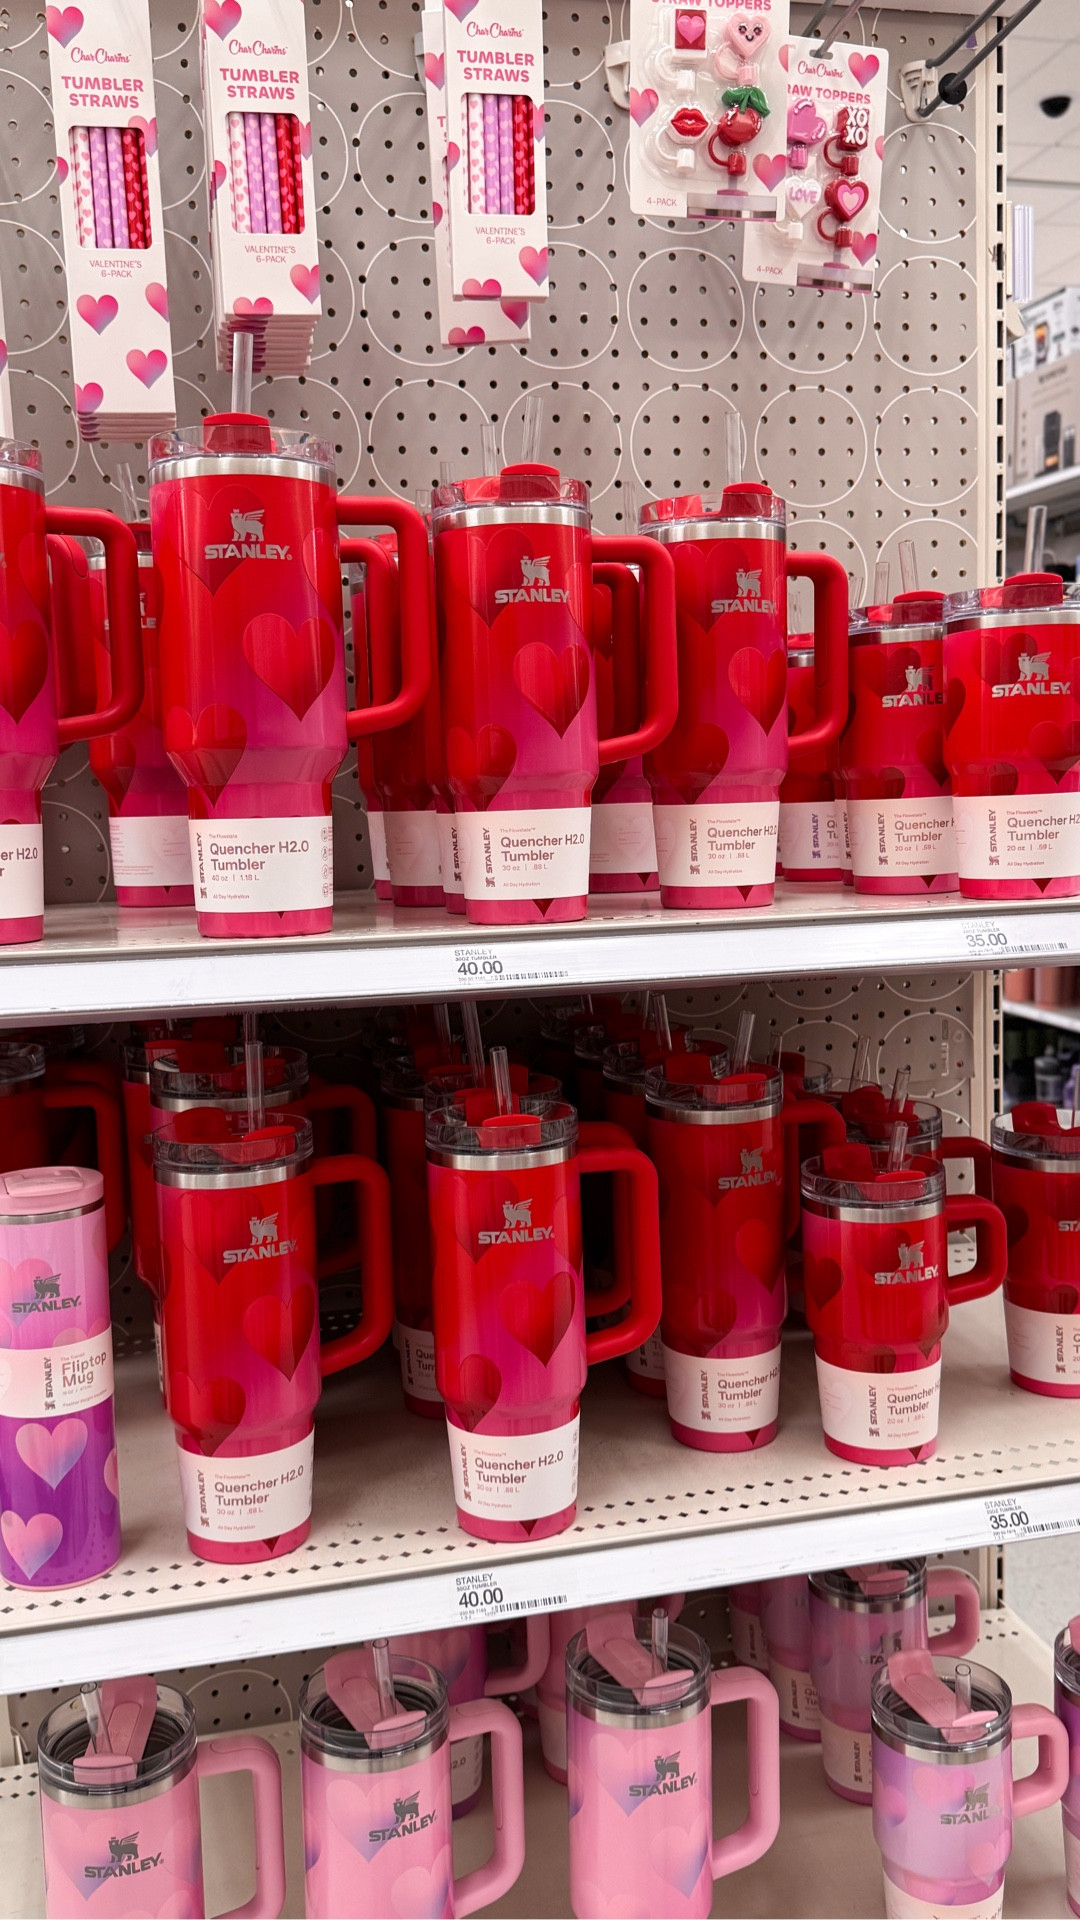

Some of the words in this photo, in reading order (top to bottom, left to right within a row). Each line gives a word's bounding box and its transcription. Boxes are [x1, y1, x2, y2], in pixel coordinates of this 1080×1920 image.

[457, 50, 535, 66] TUMBLER
[219, 68, 300, 84] TUMBLER
[463, 67, 530, 83] STRAWS
[61, 76, 144, 92] TUMBLER
[69, 93, 139, 108] STRAWS
[227, 85, 295, 100] STRAWS
[816, 87, 871, 104] TOPPERS
[846, 107, 868, 127] XO
[845, 126, 867, 145] XO
[646, 197, 677, 207] 4-PACK
[788, 187, 817, 204] LOVE
[476, 227, 526, 236] VALENTINE'S
[486, 236, 516, 245] 6-PACK
[245, 245, 296, 254] VALENTINE'S
[89, 260, 143, 269] VALENTINE'S
[255, 255, 287, 263] 6-PACK
[101, 269, 132, 278] 6-PACK
[204, 543, 291, 560] STANLEY
[494, 588, 570, 604] STANLEY
[711, 598, 777, 613] STANLEY
[991, 681, 1069, 698] STANLEY
[882, 692, 943, 708] STANLE
[894, 818, 950, 831] Quencher
[1007, 816, 1068, 828] Quencher
[1069, 814, 1080, 824] H2
[707, 826, 763, 838] Quencher
[878, 813, 886, 853] STANLEY
[894, 832, 943, 842] Tumbler
[988, 809, 997, 853] STANLEY
[1007, 830, 1060, 841] Tumbler
[210, 842, 276, 856] Quencher
[278, 840, 309, 853] H2.0
[500, 836, 563, 848] Quencher
[565, 834, 585, 845] H2.0
[689, 818, 698, 862] STANLEY
[707, 840, 756, 851] Tumbler
[16, 847, 39, 860] H2.0
[196, 832, 206, 883] STANLEY
[483, 827, 493, 874] STANLEY
[501, 850, 555, 862] Tumbler
[210, 858, 266, 871] Tumbler
[966, 932, 1008, 947] 35.00
[454, 949, 493, 957] STANLEY
[457, 960, 503, 975] 40.00
[478, 1226, 553, 1244] STANLEY
[223, 1238, 297, 1264] STANLEY
[874, 1264, 937, 1285] STANLEY
[12, 1296, 81, 1313] STANLEY
[61, 1351, 107, 1376] Fliptop
[44, 1357, 54, 1398] STANLEY
[62, 1370, 94, 1388] Mug
[718, 1374, 768, 1389] Quencher
[700, 1370, 709, 1408] STANLEY
[718, 1388, 762, 1401] Tumbler
[887, 1386, 934, 1404] Quencher
[868, 1385, 878, 1425] STANLEY
[887, 1401, 930, 1415] Tumbler
[475, 1457, 536, 1471] Quencher
[538, 1450, 564, 1467] H2.0
[214, 1479, 279, 1493] Quencher
[280, 1464, 304, 1485] H2.0
[475, 1470, 527, 1484] Tumbler
[215, 1493, 270, 1506] Tumbler
[984, 1498, 1017, 1509] STANLEY
[989, 1511, 1029, 1530] 35.00
[455, 1573, 494, 1586] STANLEY
[471, 1581, 498, 1589] TUMBLER
[458, 1587, 504, 1608] 40.00
[452, 1756, 466, 1769] 2.0
[629, 1772, 696, 1797] STANLEY
[369, 1809, 436, 1842] STANLEY
[940, 1811, 989, 1825] STANL
[84, 1852, 162, 1878] STANLEY
